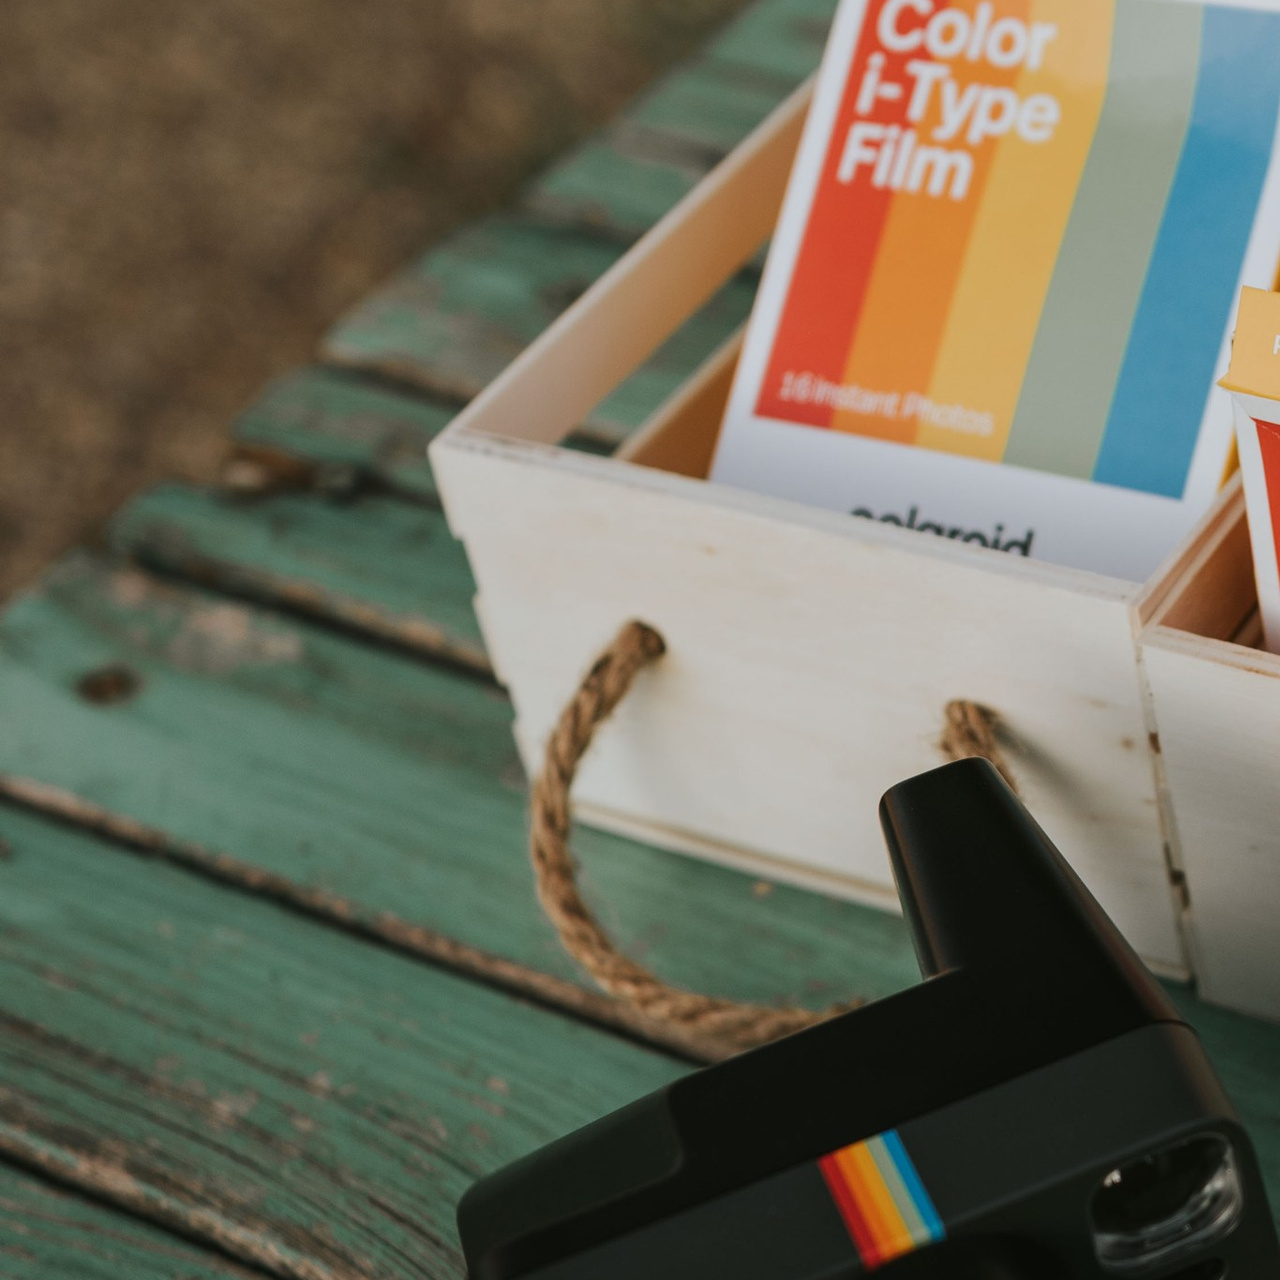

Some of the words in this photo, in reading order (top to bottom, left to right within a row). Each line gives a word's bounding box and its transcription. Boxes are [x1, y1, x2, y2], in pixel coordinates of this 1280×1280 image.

[855, 51, 1061, 145] i-Type
[836, 121, 975, 202] Film
[813, 376, 899, 418] Instant
[901, 391, 996, 437] Photos
